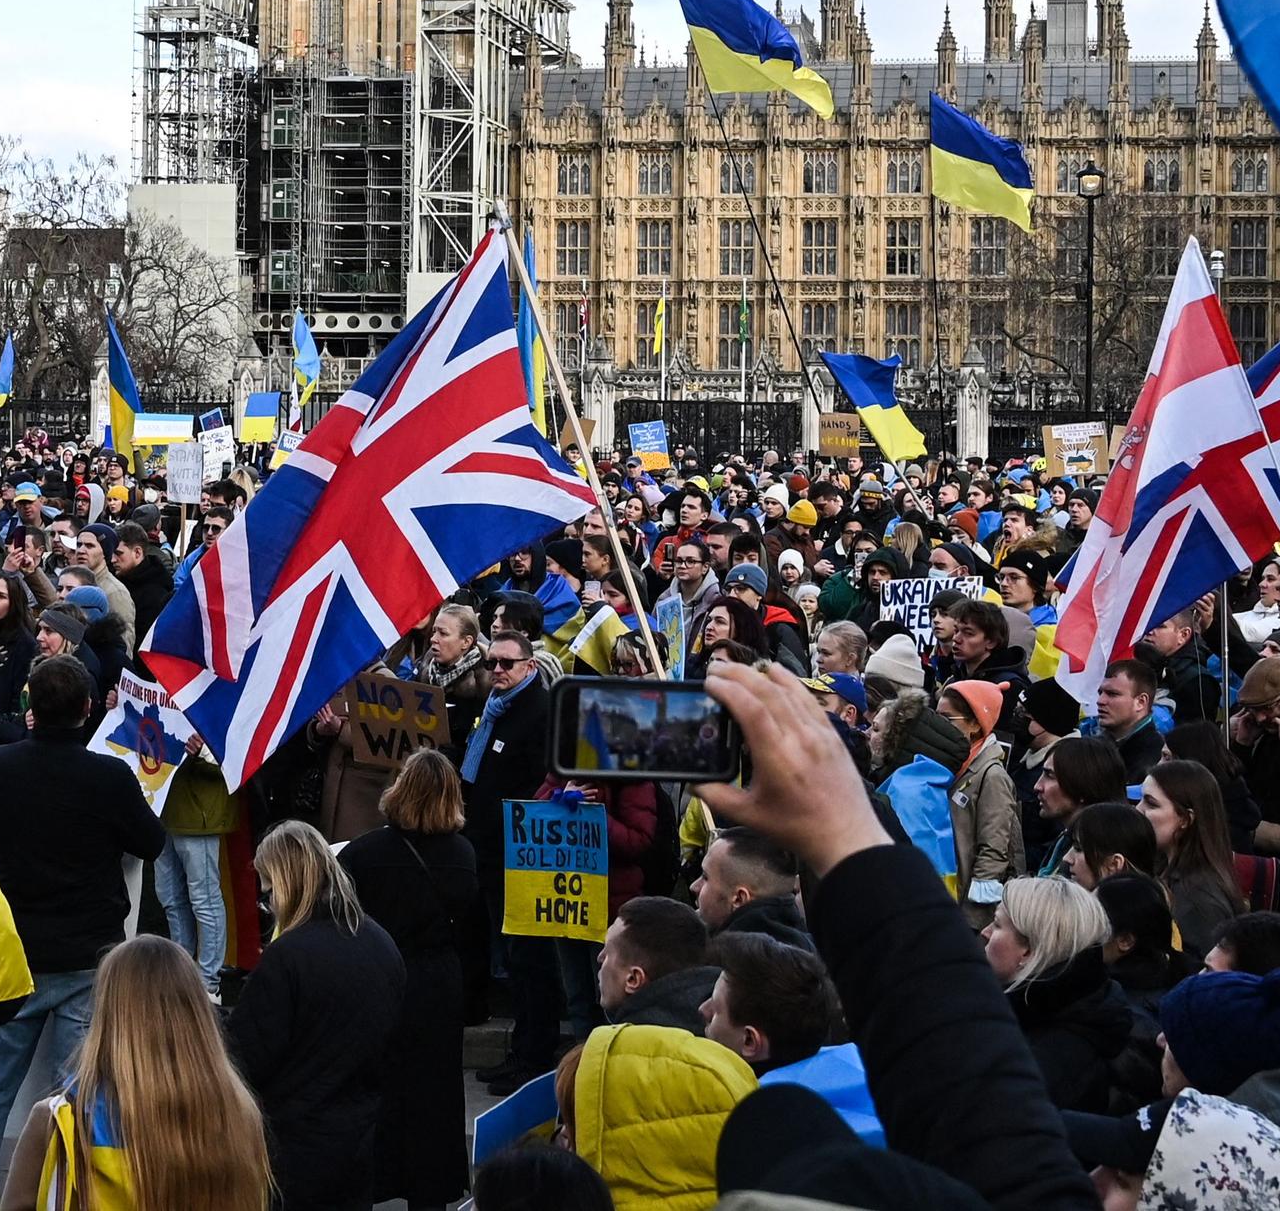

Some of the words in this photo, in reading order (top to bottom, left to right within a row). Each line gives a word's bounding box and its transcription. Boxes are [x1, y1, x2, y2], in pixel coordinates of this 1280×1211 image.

[820, 420, 852, 430] HANDS
[144, 687, 158, 706] FOR
[356, 680, 406, 722] NO
[516, 848, 598, 870] SOLDIERS
[553, 872, 583, 896] GO
[535, 897, 589, 926] HOME
